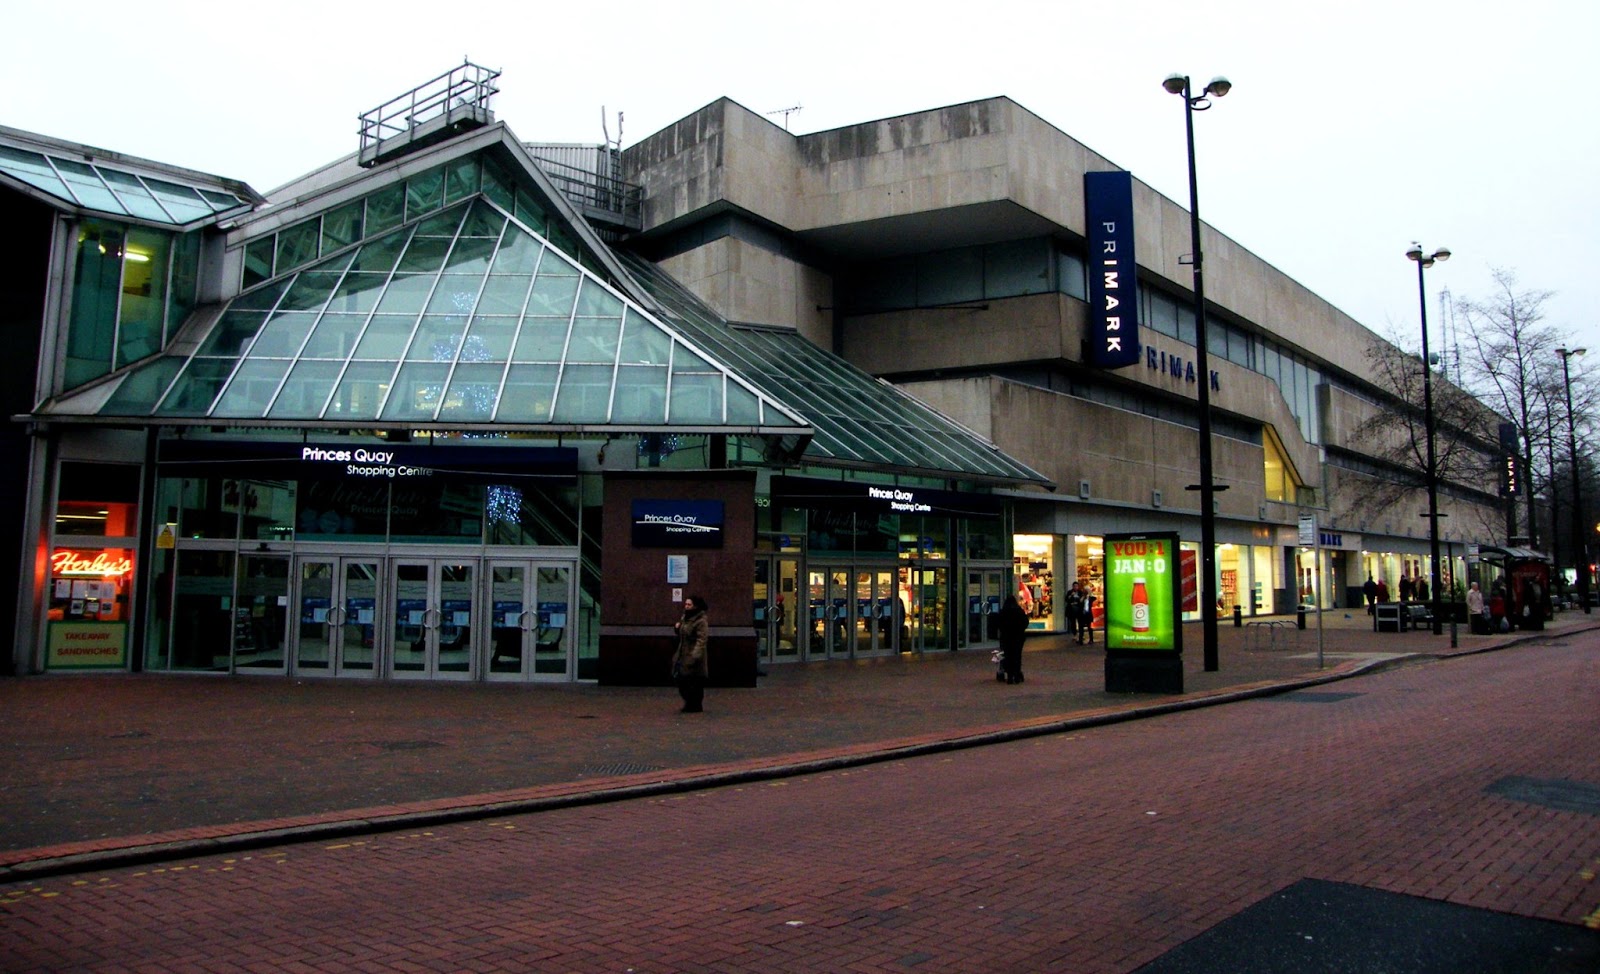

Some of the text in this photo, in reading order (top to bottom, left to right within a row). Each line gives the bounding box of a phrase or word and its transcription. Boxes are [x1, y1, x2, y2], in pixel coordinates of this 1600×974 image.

[1102, 221, 1122, 353] PRIMARK
[1138, 344, 1220, 392] RIMAK
[302, 447, 394, 465] Princes Quay
[346, 464, 433, 478] Shopping Centre
[868, 487, 914, 502] Princes Quay
[891, 501, 932, 512] Shopping Centre
[644, 514, 697, 524] Princes Quay
[1319, 533, 1343, 546] MARK
[51, 551, 132, 577] Herby's
[64, 632, 111, 641] TAKEAWAY
[57, 647, 119, 656] SANDWICHES
